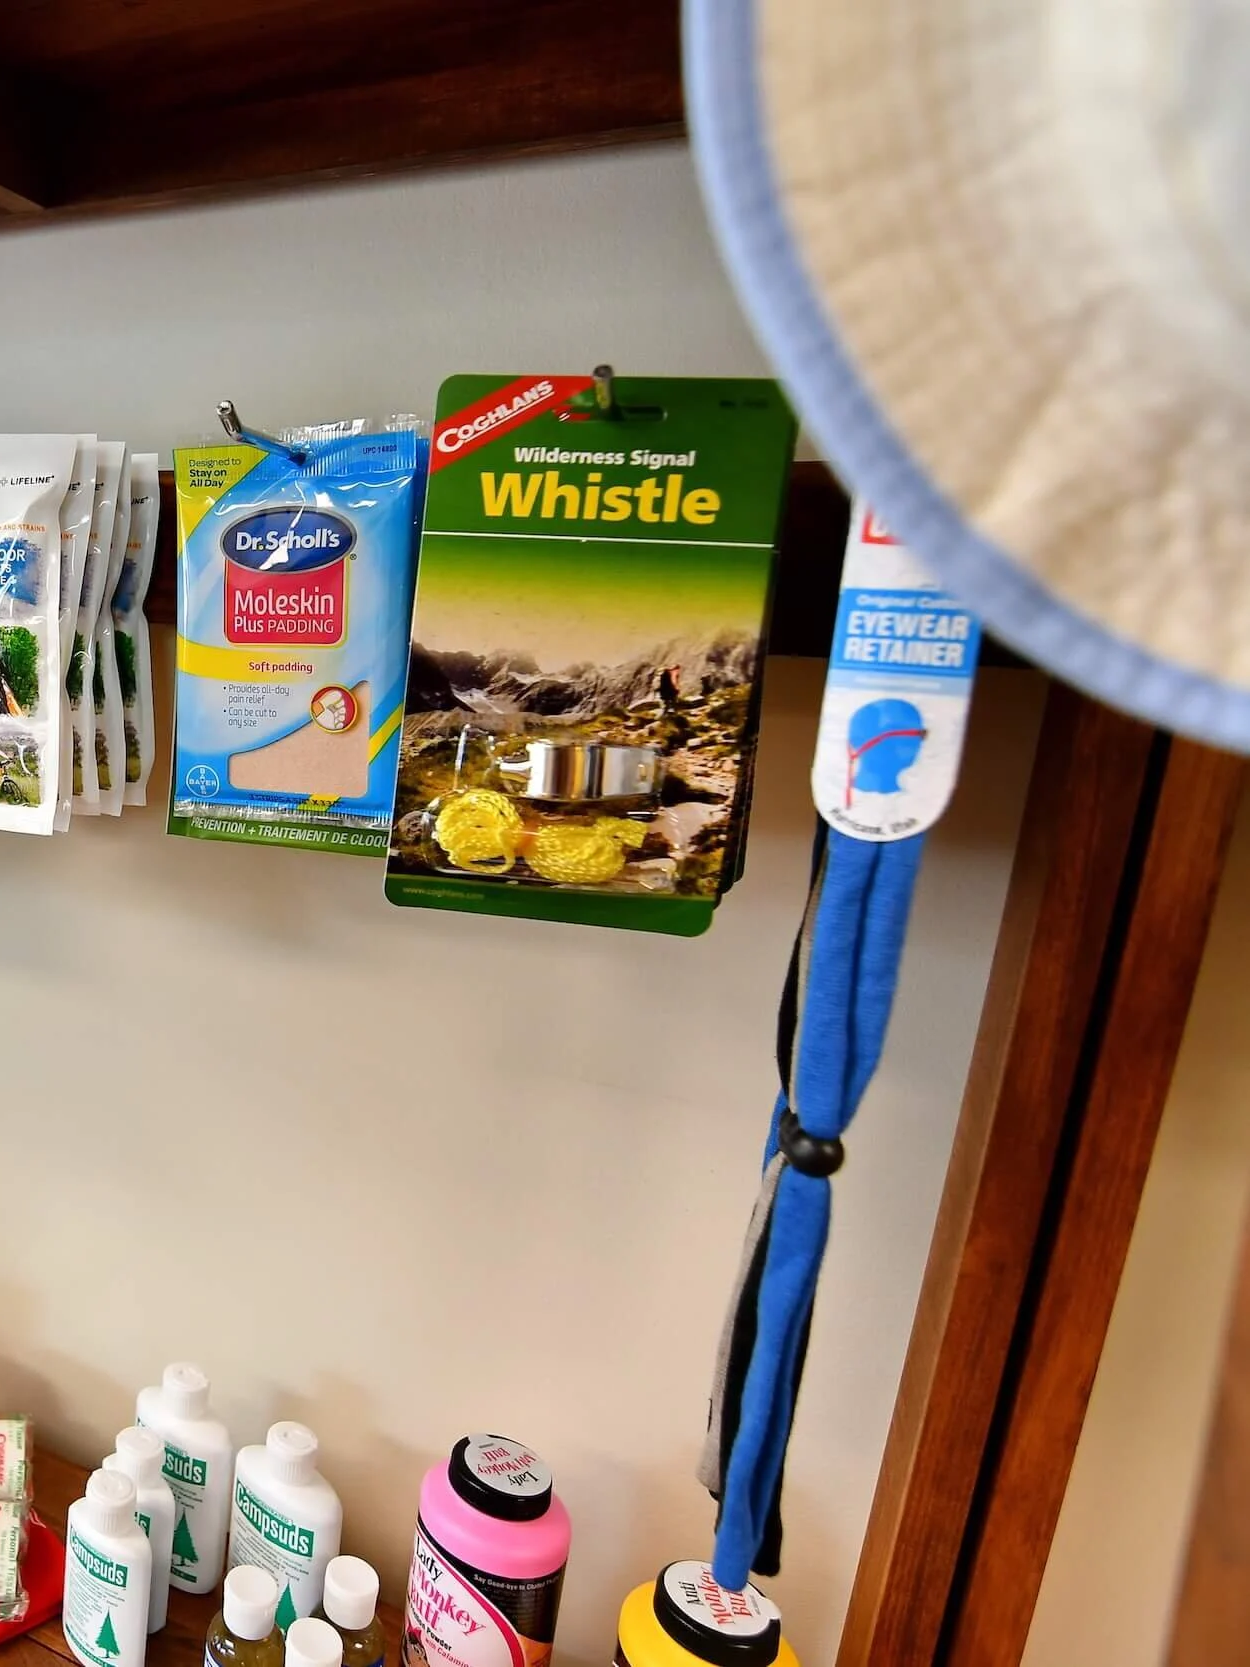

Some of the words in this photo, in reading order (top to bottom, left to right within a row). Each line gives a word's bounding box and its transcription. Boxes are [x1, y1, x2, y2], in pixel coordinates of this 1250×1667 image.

[189, 457, 226, 468] Designed
[229, 457, 241, 466] to
[514, 447, 624, 466] Wilderness
[630, 450, 696, 469] Signal
[10, 475, 54, 486] LIFELINE
[189, 468, 212, 479] Stay
[214, 469, 227, 477] on
[189, 479, 203, 488] All
[204, 479, 224, 489] Day
[481, 470, 721, 525] Whistle
[18, 524, 46, 533] STRAINS
[234, 587, 334, 616] Moleskin
[234, 616, 263, 633] Plus
[267, 618, 334, 633] PADDING
[846, 610, 970, 641] EYEWEAR
[843, 637, 965, 668] RETAINER
[249, 661, 271, 672] Soft
[272, 662, 313, 675] padding
[228, 684, 260, 694] Provides
[261, 685, 290, 696] all-day
[228, 695, 244, 705] pain
[245, 695, 265, 705] relief
[228, 707, 242, 717] Can
[243, 708, 252, 717] be
[254, 708, 267, 718] cut
[268, 709, 277, 718] to
[228, 718, 242, 729] any
[243, 717, 258, 727] size
[188, 778, 217, 786] BAYER
[258, 824, 329, 842] TRAITEMENT
[332, 832, 348, 845] DE
[482, 1447, 511, 1462] Butt
[507, 1470, 539, 1487] Lady
[236, 1483, 310, 1555] Campsuds
[70, 1527, 127, 1586] Campsuds
[416, 1536, 444, 1582] Lady
[473, 1573, 488, 1586] Say
[487, 1578, 518, 1591] Good-bye
[416, 1566, 487, 1637] Monkey
[678, 1580, 705, 1607] Anti
[426, 1627, 453, 1652] Powder
